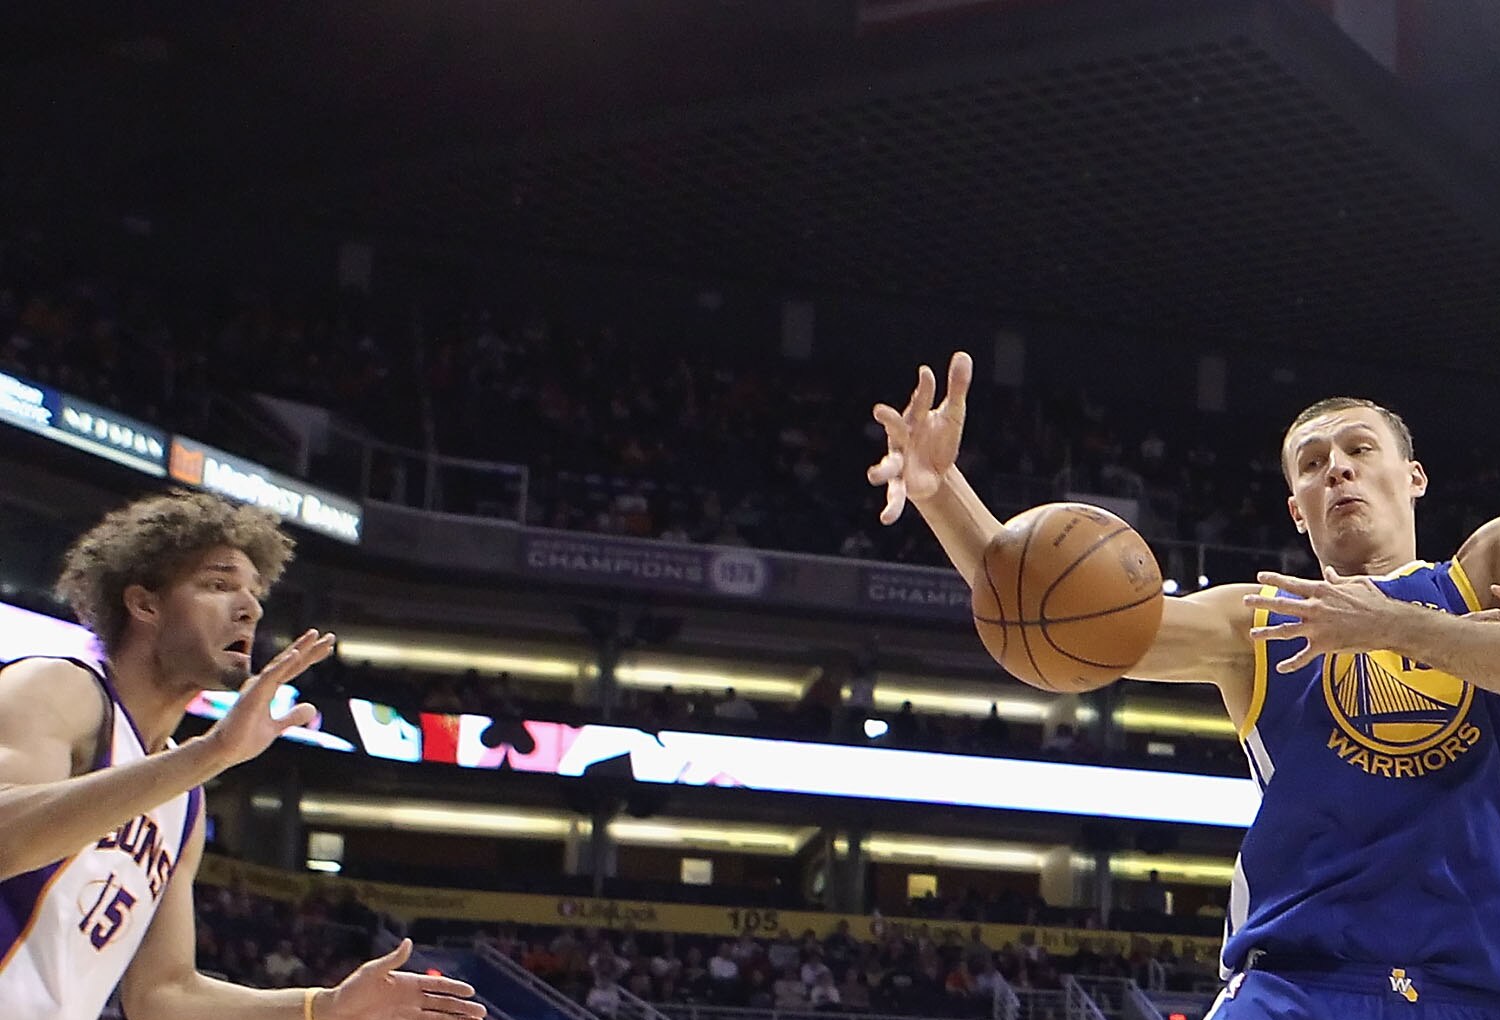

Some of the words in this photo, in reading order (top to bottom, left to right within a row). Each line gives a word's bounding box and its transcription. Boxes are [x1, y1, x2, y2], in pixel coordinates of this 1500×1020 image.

[527, 552, 703, 581] CHAMPIONS
[1326, 722, 1481, 778] WARRIORS
[78, 872, 137, 951] 15
[729, 907, 778, 930] 105
